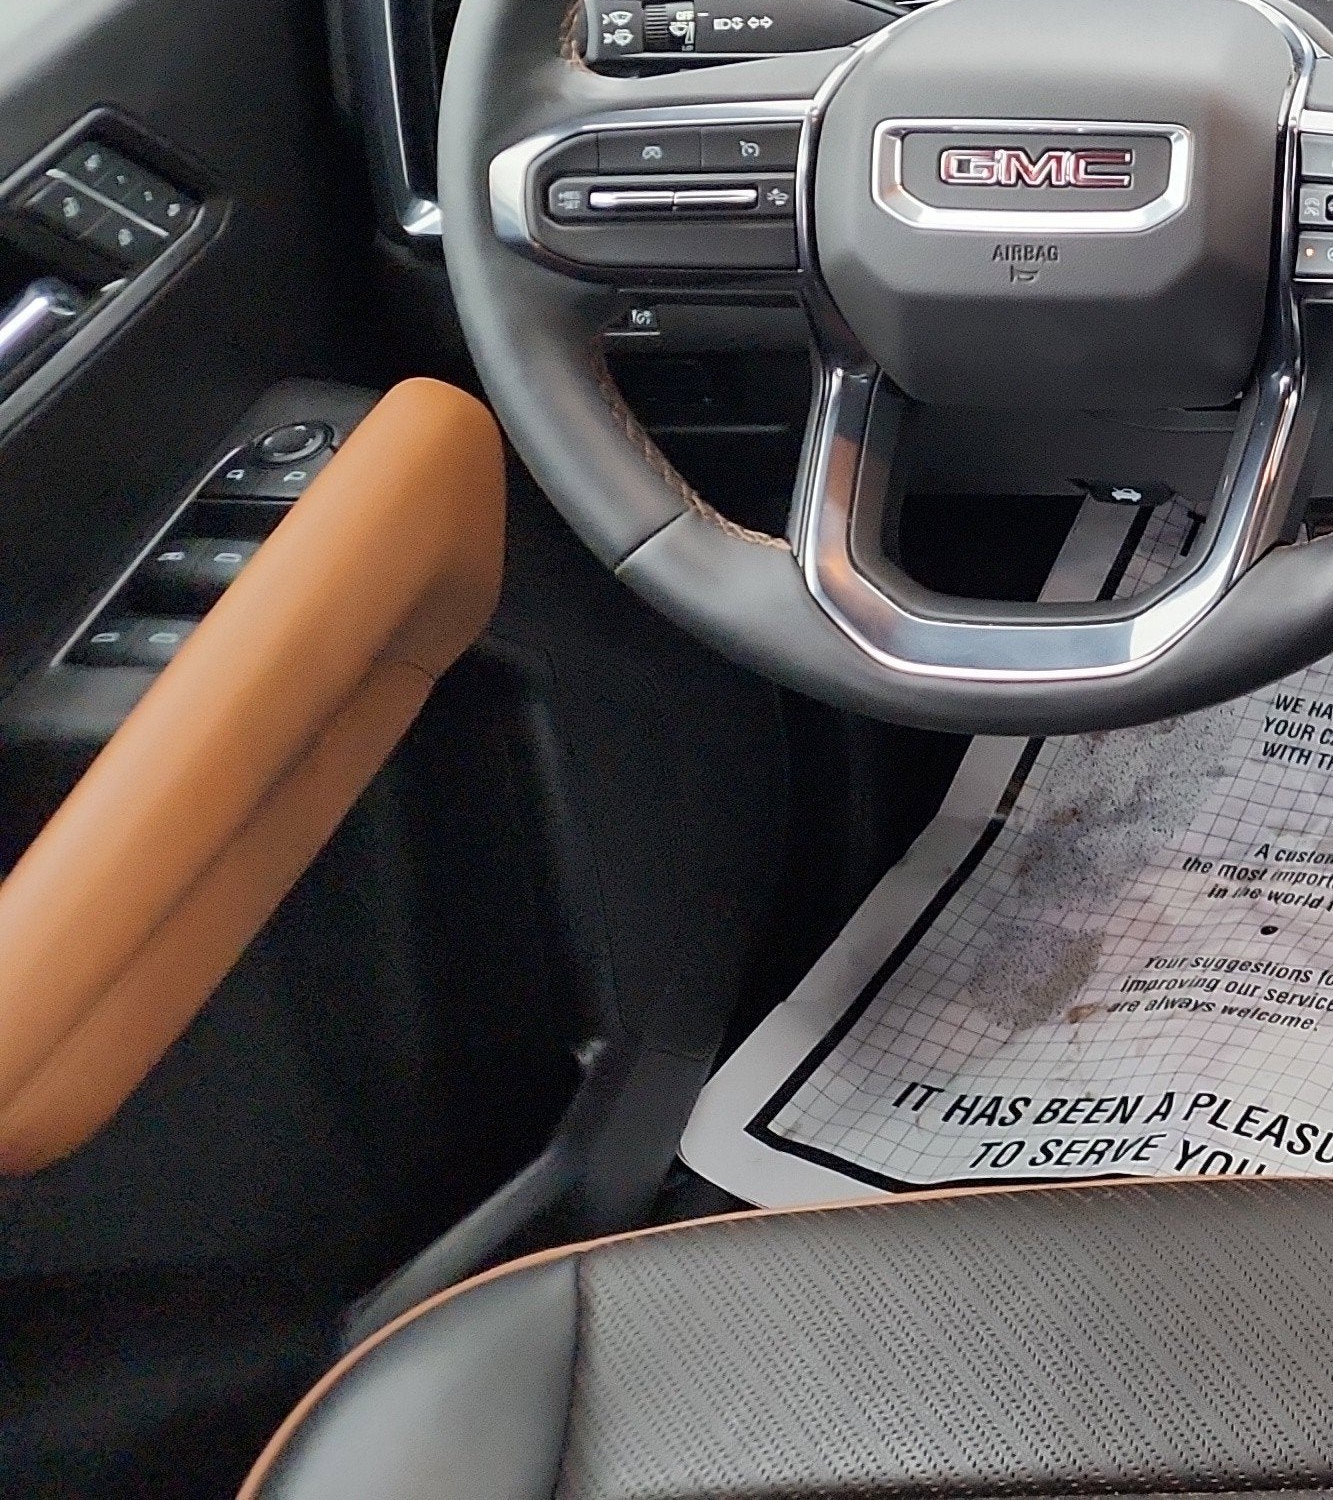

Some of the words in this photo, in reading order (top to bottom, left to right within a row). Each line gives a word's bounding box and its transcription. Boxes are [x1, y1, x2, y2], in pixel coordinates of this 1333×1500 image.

[937, 147, 1132, 189] GMC
[991, 245, 1059, 263] AIRBAG
[1275, 694, 1304, 713] WE
[1263, 716, 1315, 741] YOUR
[1261, 741, 1311, 766] WITH
[1255, 843, 1271, 858] A
[1183, 857, 1213, 874] the
[1219, 864, 1267, 883] most
[1208, 885, 1228, 900] in
[1268, 891, 1322, 911] world
[1145, 955, 1186, 972] Your
[1191, 954, 1313, 983] suggestions
[1121, 976, 1219, 995] improving
[1226, 979, 1260, 1000] our
[1108, 999, 1140, 1014] are
[1145, 996, 1215, 1015] always
[1221, 1004, 1319, 1032] welcome.
[893, 1082, 945, 1110] IT
[942, 1095, 1031, 1127] HAS
[1033, 1095, 1144, 1126] BEEN
[1143, 1091, 1174, 1123] A
[969, 1141, 1026, 1169] TO
[1029, 1134, 1167, 1167] SERVE
